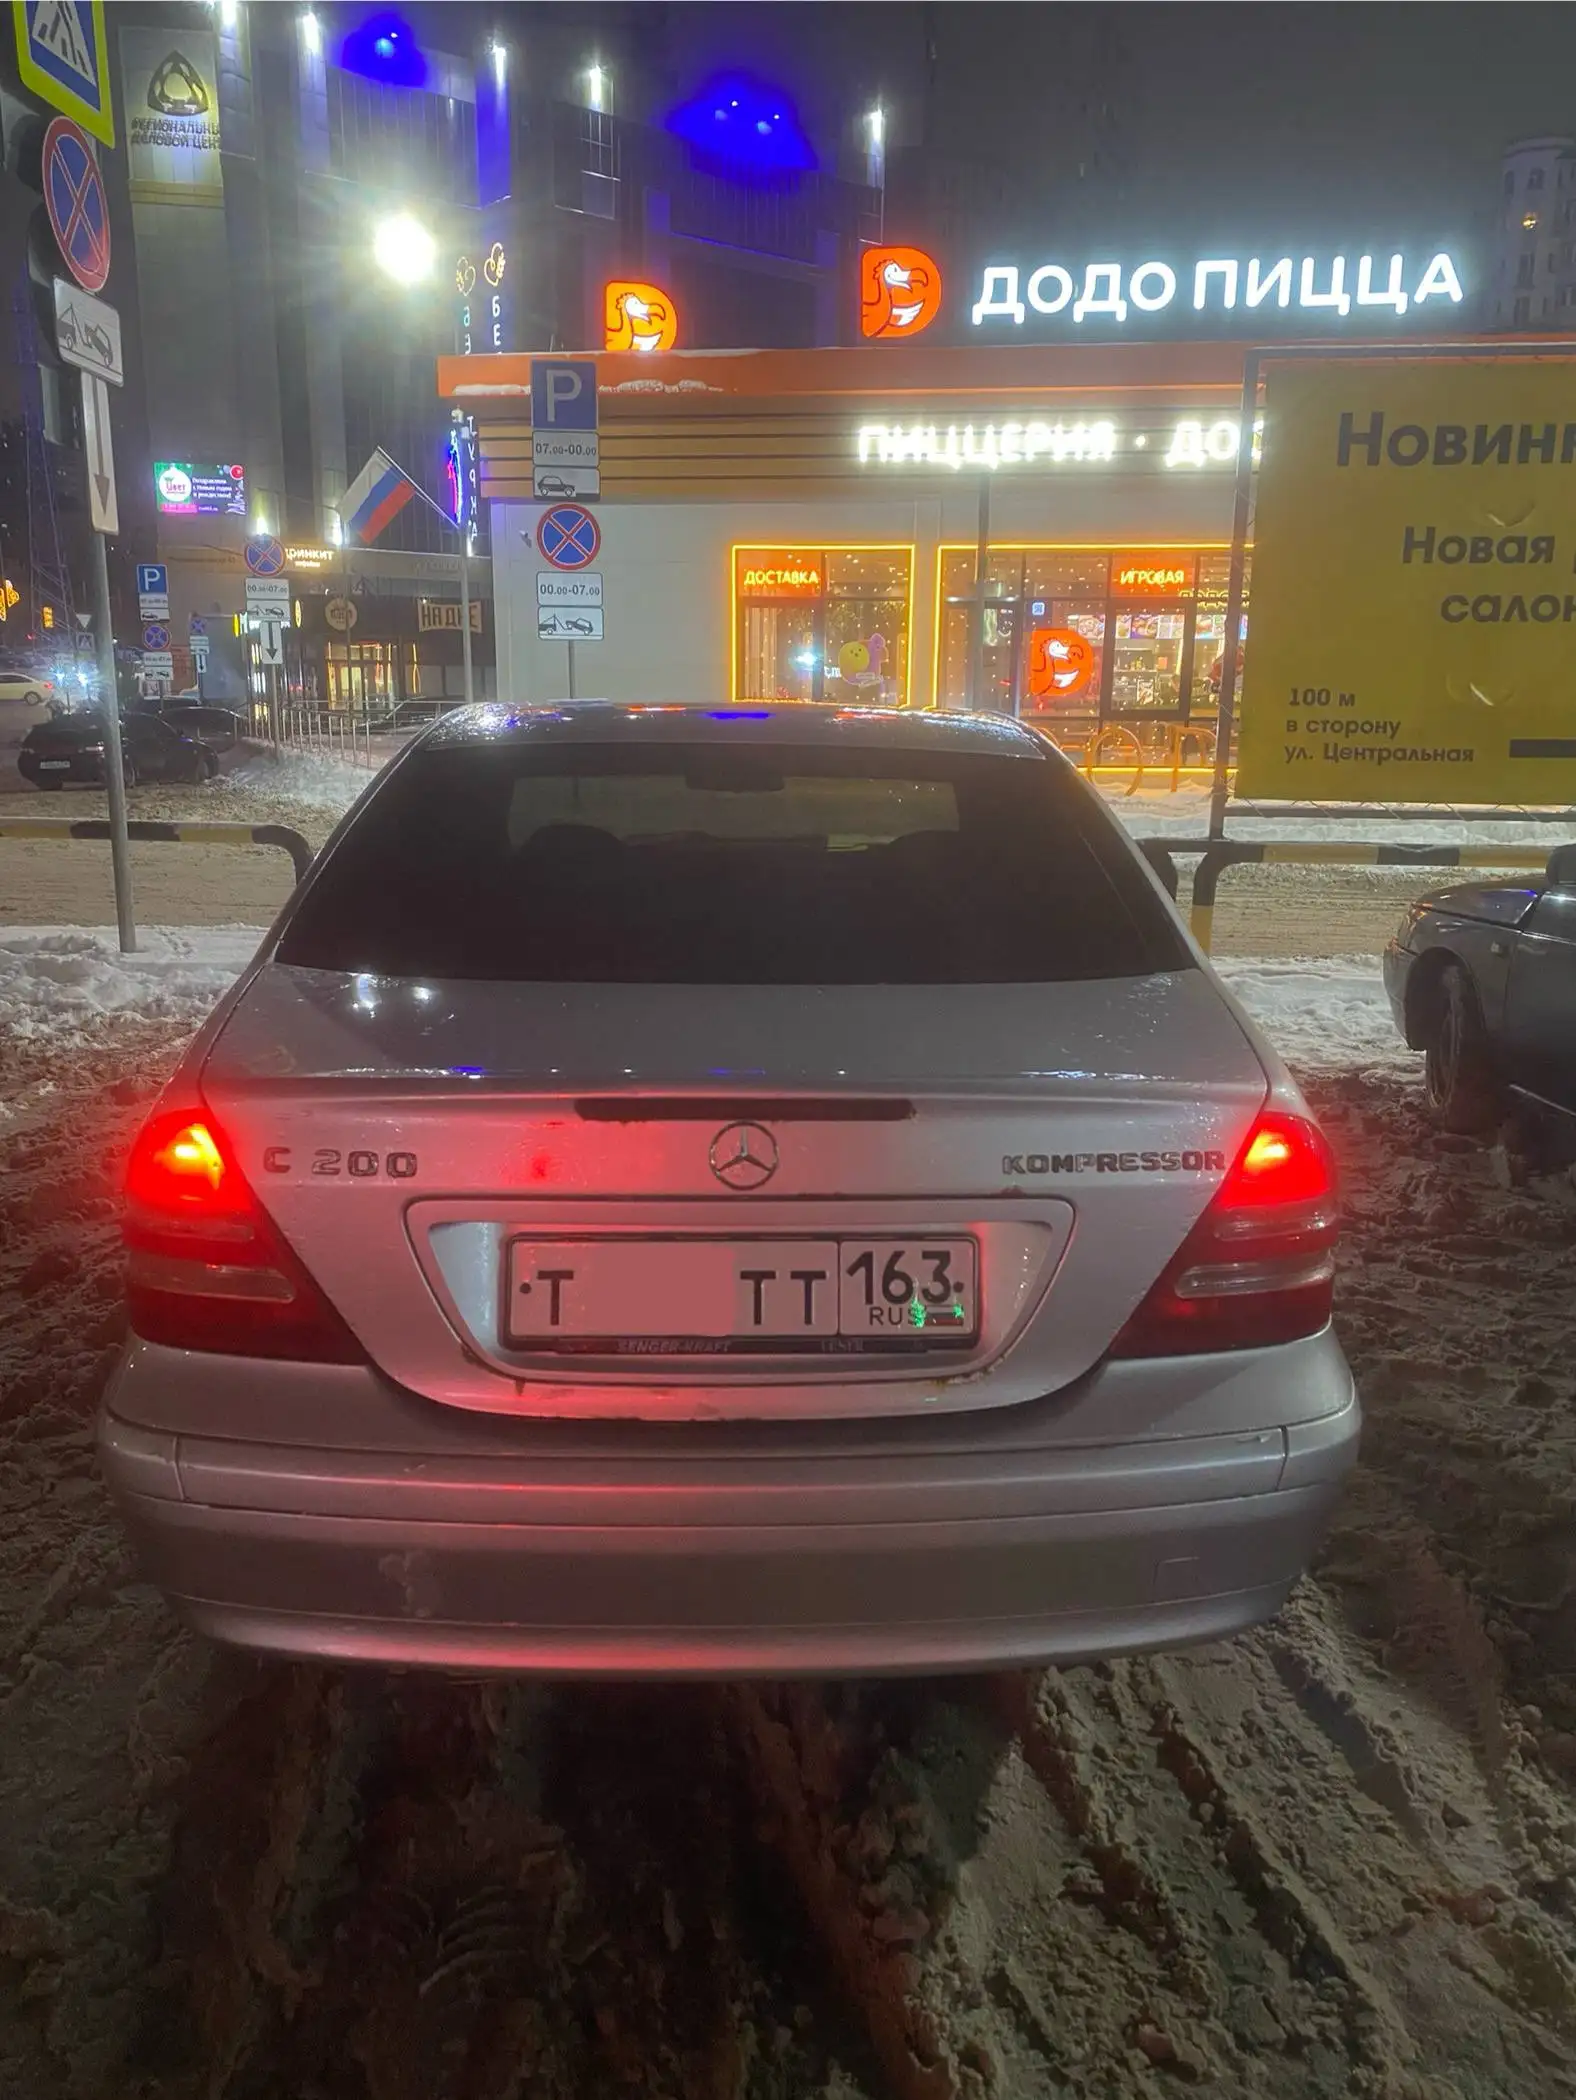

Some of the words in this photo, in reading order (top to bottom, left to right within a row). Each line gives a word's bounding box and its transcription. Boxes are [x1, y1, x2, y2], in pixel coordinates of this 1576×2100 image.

[972, 261, 1177, 326] ДОДО
[1193, 252, 1464, 316] ПИЦЦА
[546, 369, 582, 422] P
[535, 443, 597, 456] 07.00-00.00
[858, 422, 1116, 470] ПИЦЦЕРИЯ
[1402, 526, 1555, 564] Новая
[744, 570, 819, 585] ДОСТАВКА
[1120, 569, 1185, 585] ИГРОВАЯ
[540, 584, 600, 596] 00.00-07.00
[421, 604, 442, 627] НА
[1289, 687, 1331, 707] 100
[1338, 692, 1356, 707] м
[1286, 719, 1298, 733] в
[1305, 718, 1401, 739] сторону
[1284, 745, 1314, 764] ул.
[1322, 743, 1475, 765] Центральная
[263, 1146, 291, 1174] C
[311, 1148, 418, 1178] 200
[1002, 1151, 1226, 1175] KOMPRESSOR
[846, 1250, 951, 1305] 163
